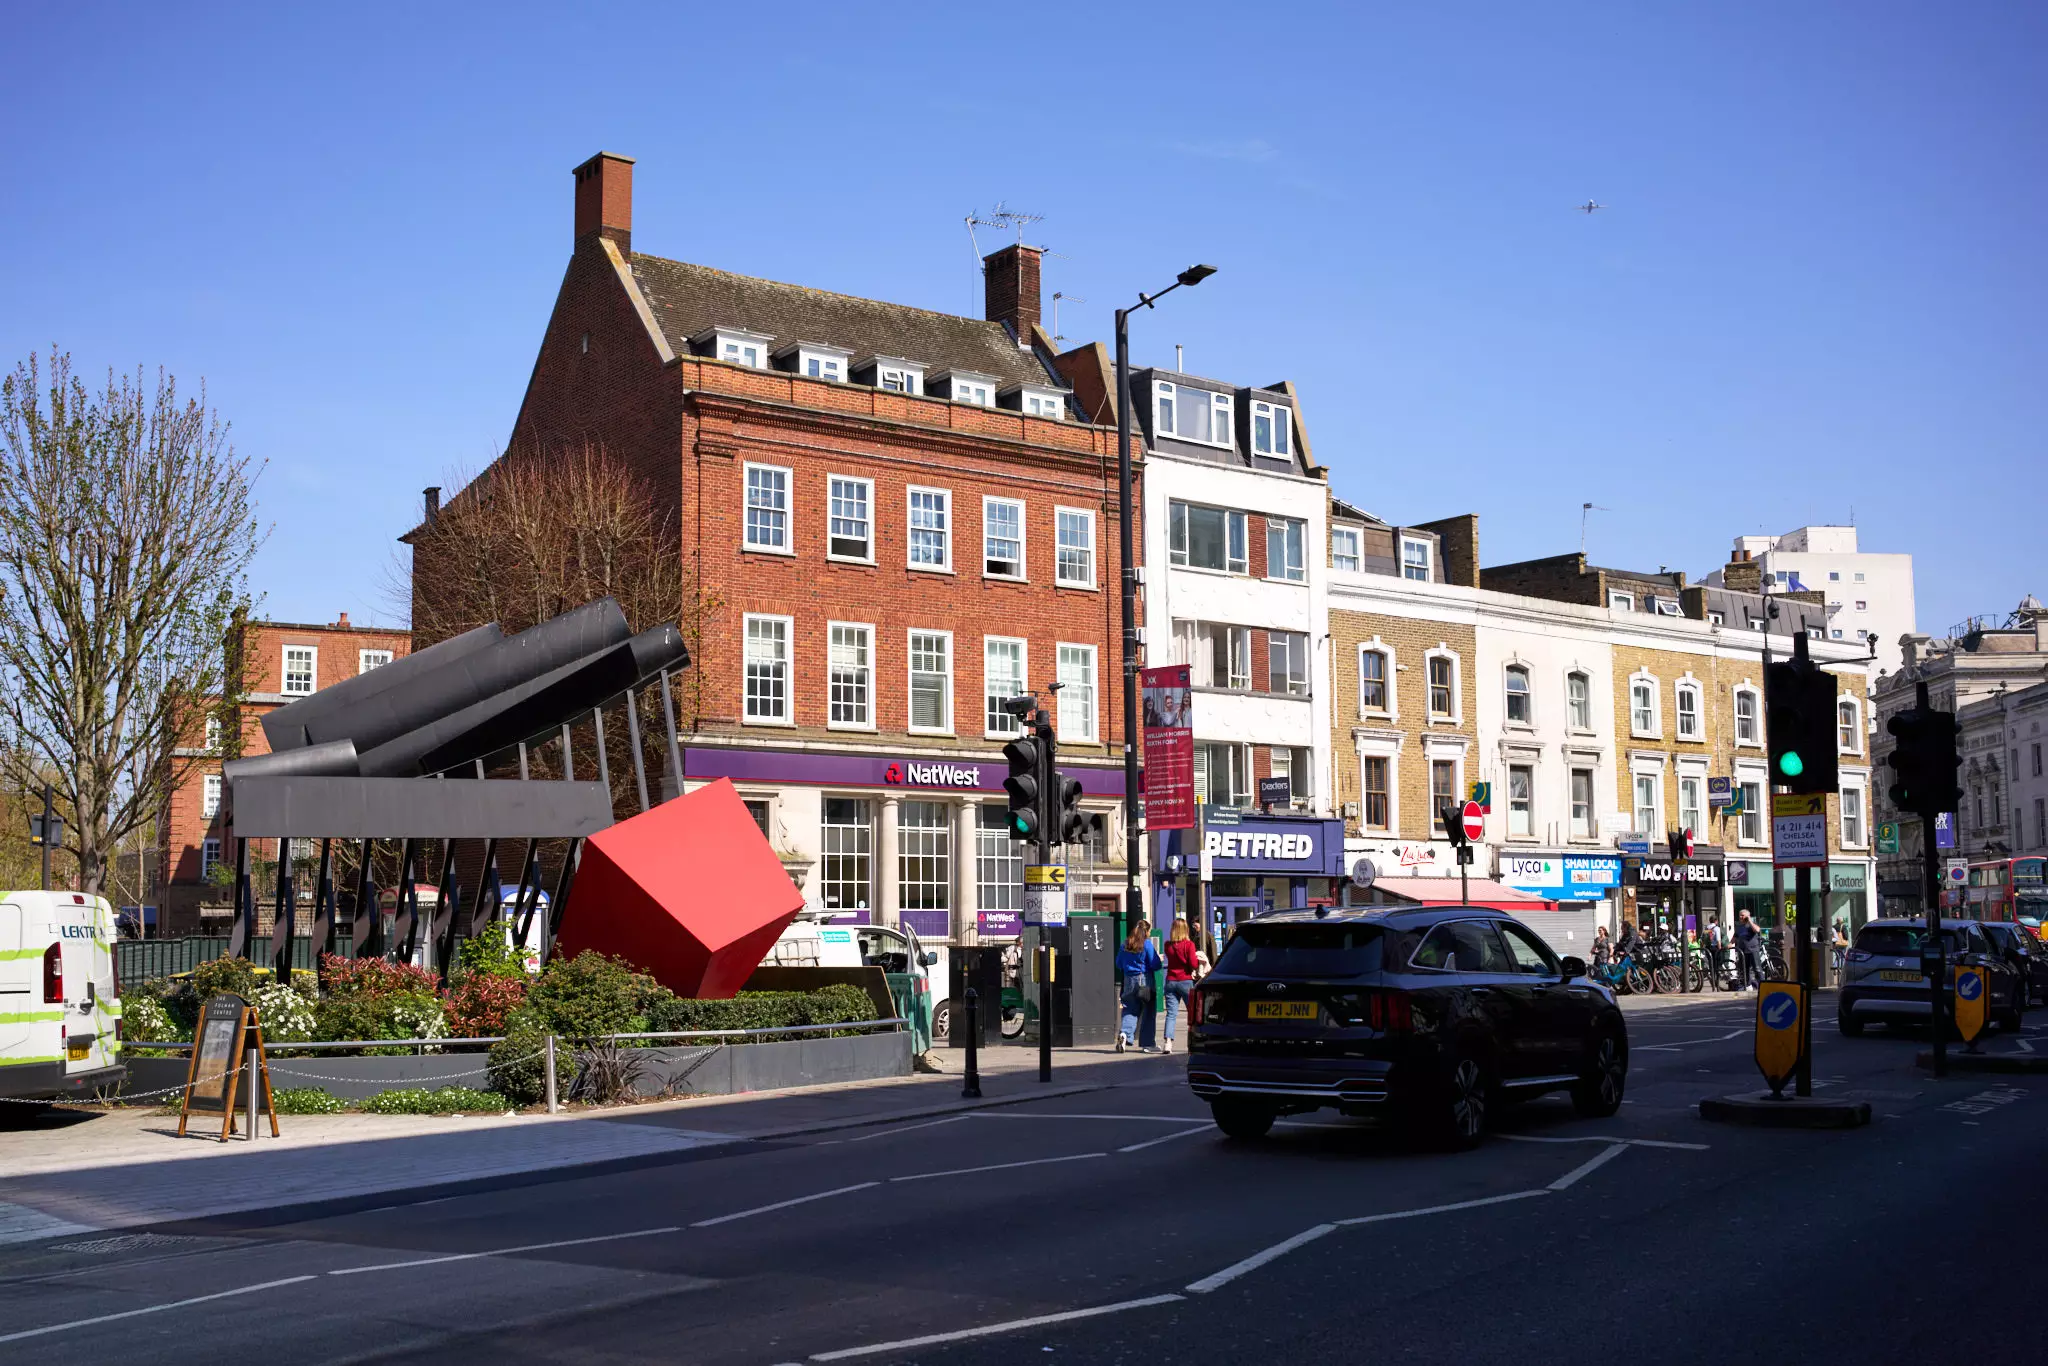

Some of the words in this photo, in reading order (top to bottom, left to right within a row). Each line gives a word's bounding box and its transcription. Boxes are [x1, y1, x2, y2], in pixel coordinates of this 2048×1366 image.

[1146, 732, 1168, 740] WILLIAM
[1169, 730, 1190, 738] MORRIS
[907, 763, 980, 786] NatWest
[1261, 782, 1288, 791] Dexters
[1776, 824, 1786, 832] 14
[1789, 822, 1801, 832] 211
[1805, 821, 1822, 831] 414
[1783, 832, 1815, 840] CHELSEA
[1205, 831, 1312, 859] BETFRED
[1780, 840, 1819, 849] FOOTBALL
[1512, 857, 1541, 876] Lyca
[1565, 859, 1590, 870] SHAN
[1591, 859, 1618, 870] LOCAL
[1687, 864, 1718, 882] BELL
[1834, 874, 1863, 888] Foxtons
[986, 913, 1016, 922] NatWest
[1256, 1003, 1282, 1017] MH21
[1286, 1003, 1310, 1017] JNN
